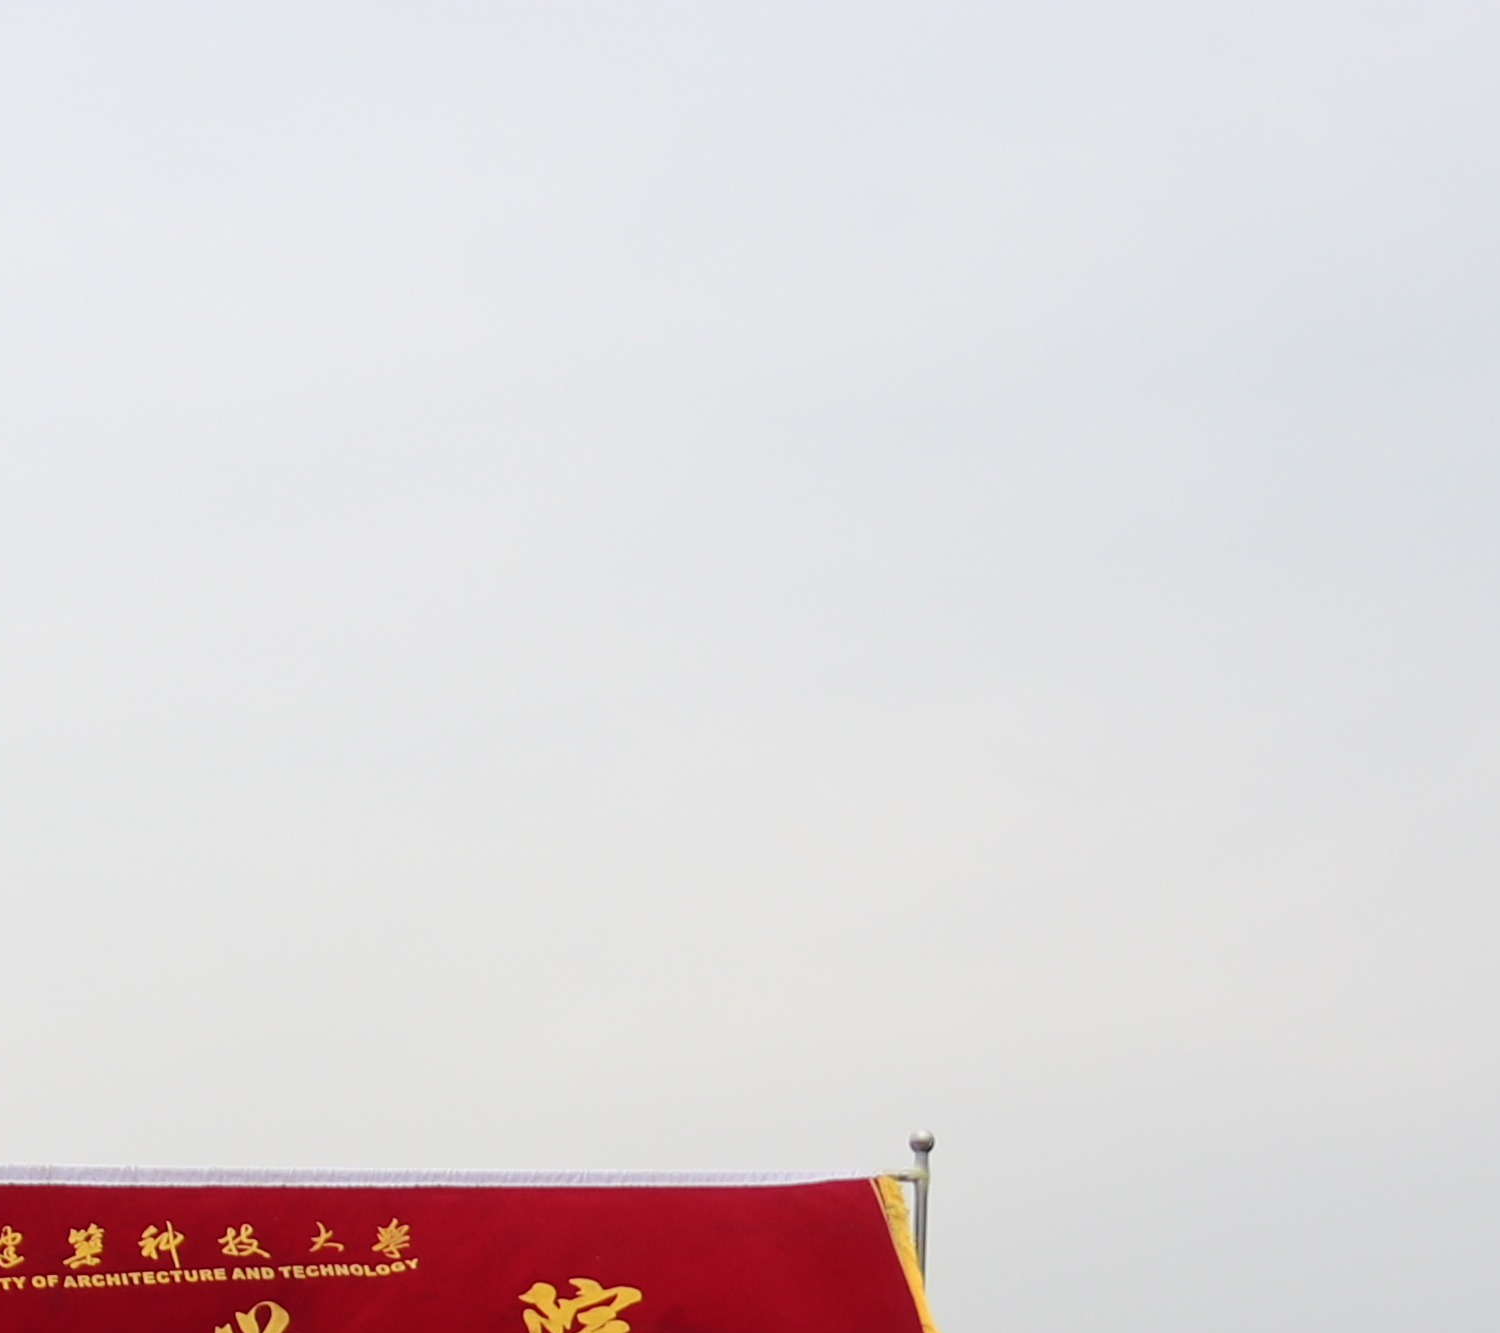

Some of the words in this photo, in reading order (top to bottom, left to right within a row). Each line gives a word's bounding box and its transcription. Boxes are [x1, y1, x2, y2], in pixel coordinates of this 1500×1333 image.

[31, 1274, 59, 1288] OF
[63, 1268, 227, 1289] ARCHITECTURE
[231, 1266, 275, 1281] AND
[278, 1258, 419, 1279] TECHNOLOGY
